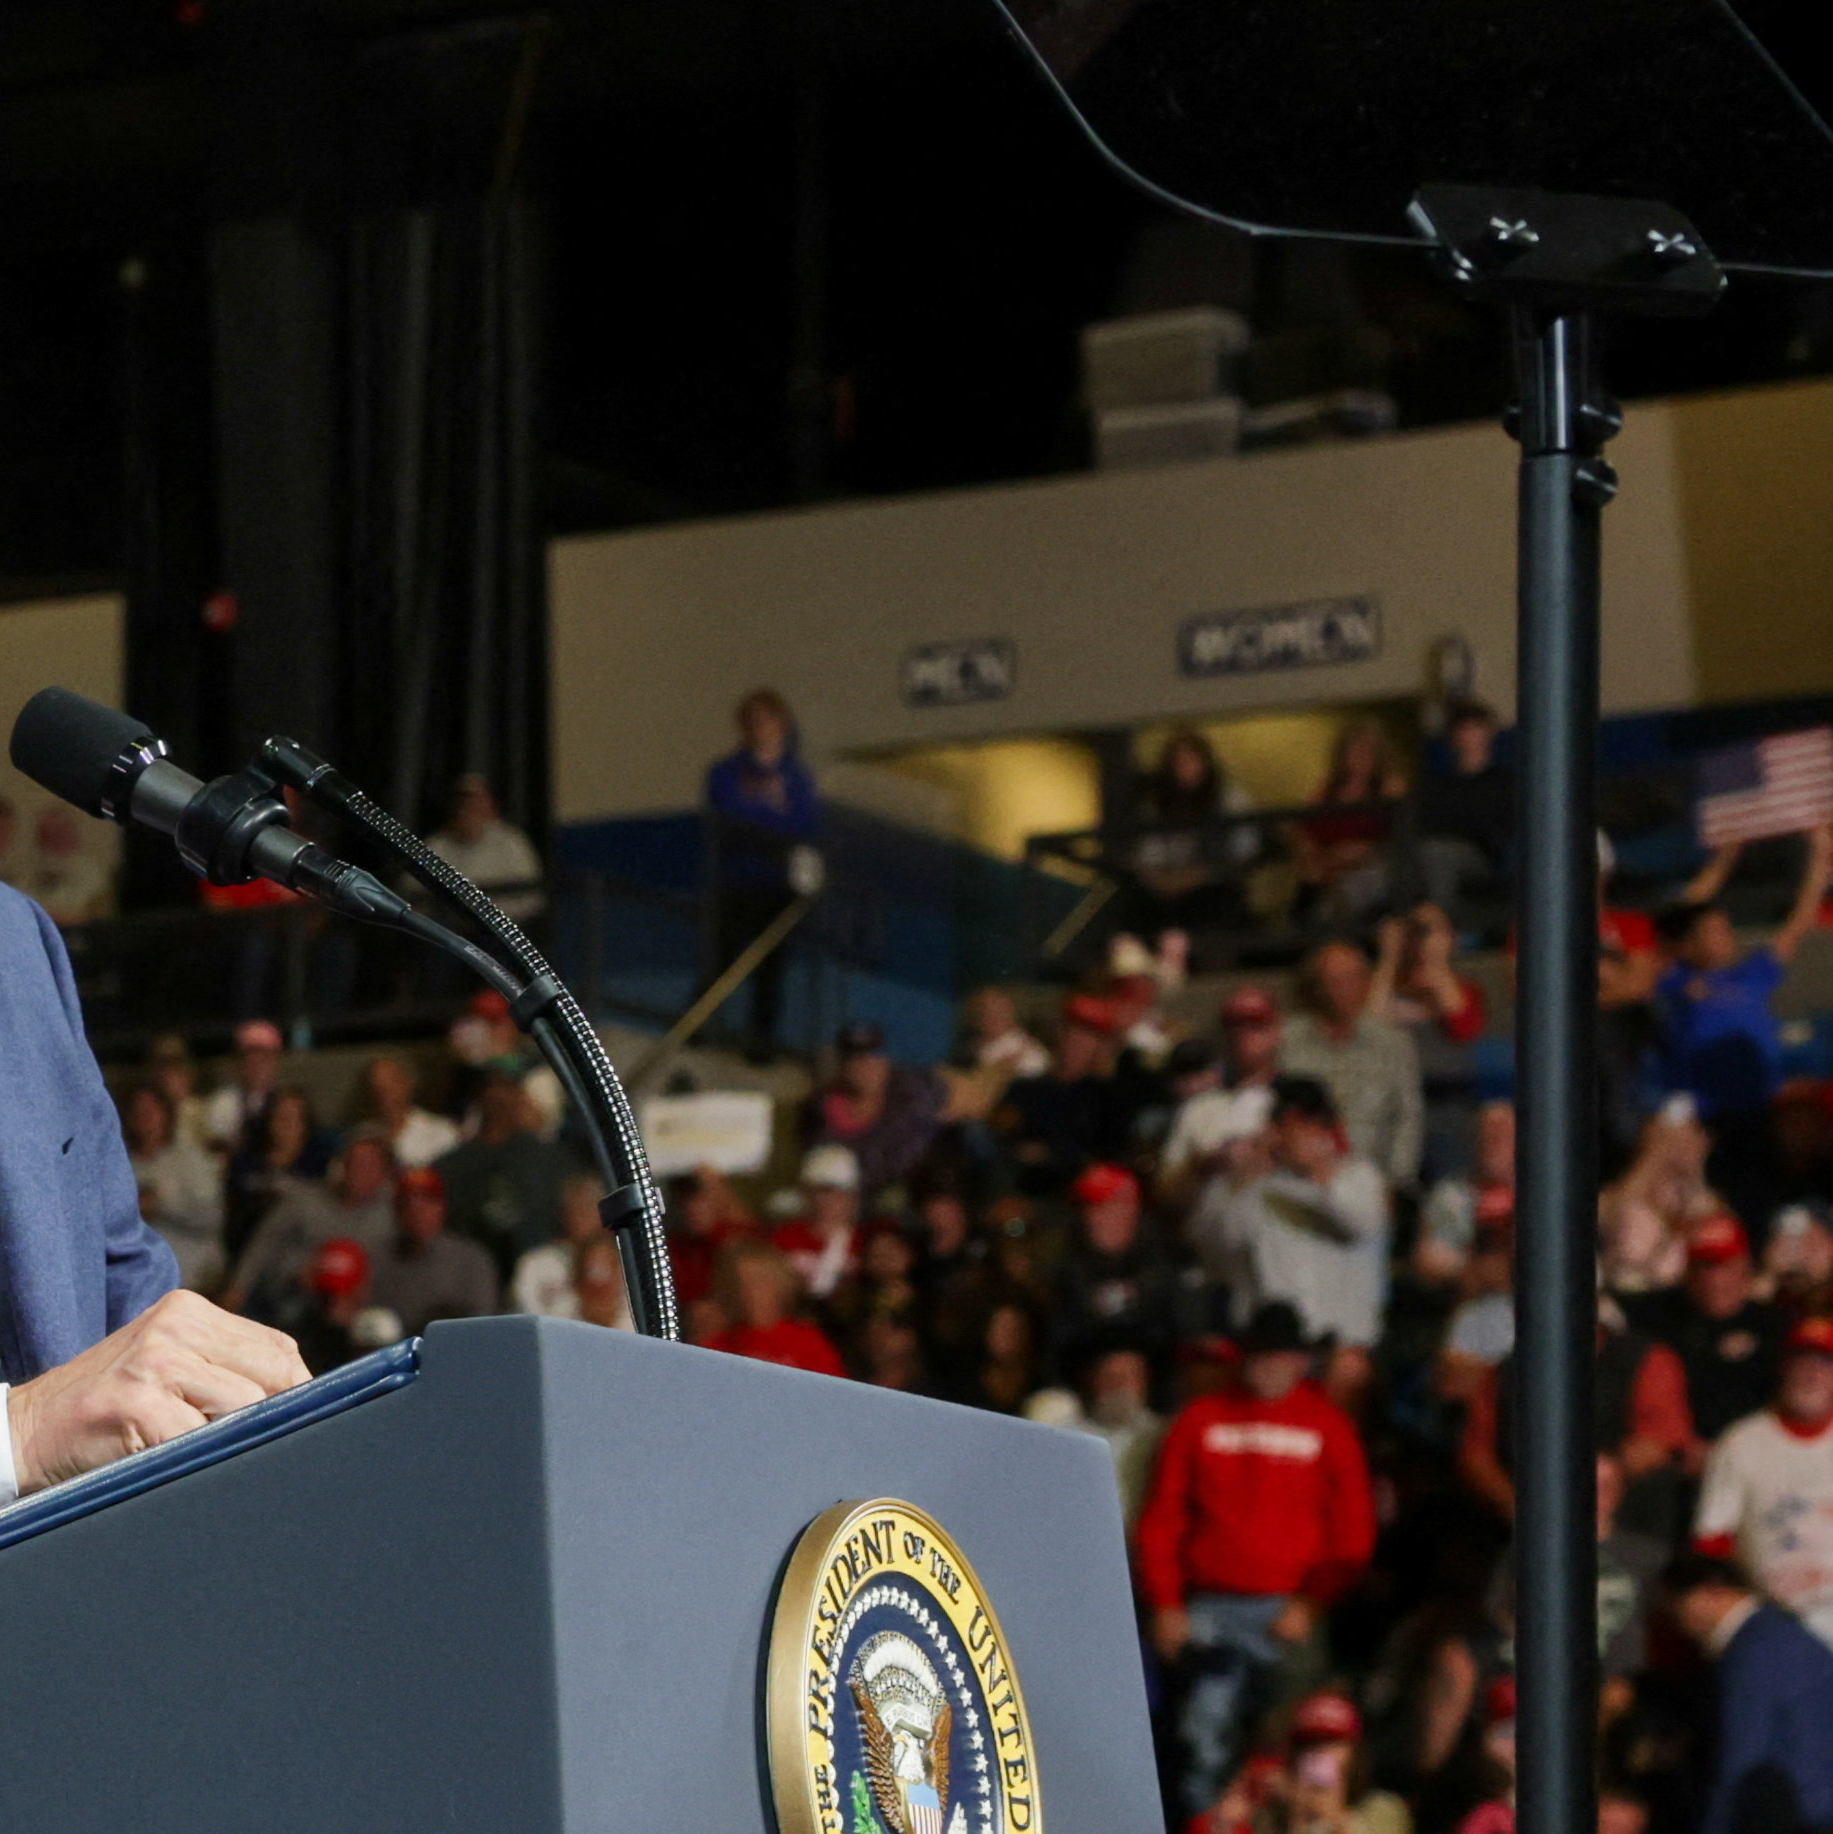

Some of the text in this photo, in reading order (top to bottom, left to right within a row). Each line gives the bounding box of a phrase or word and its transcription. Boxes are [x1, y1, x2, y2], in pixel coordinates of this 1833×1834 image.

[808, 1519, 896, 1738] PRESIDENT
[903, 1530, 925, 1564] OF
[929, 1546, 963, 1606] THE
[967, 1605, 1032, 1833] UNITED
